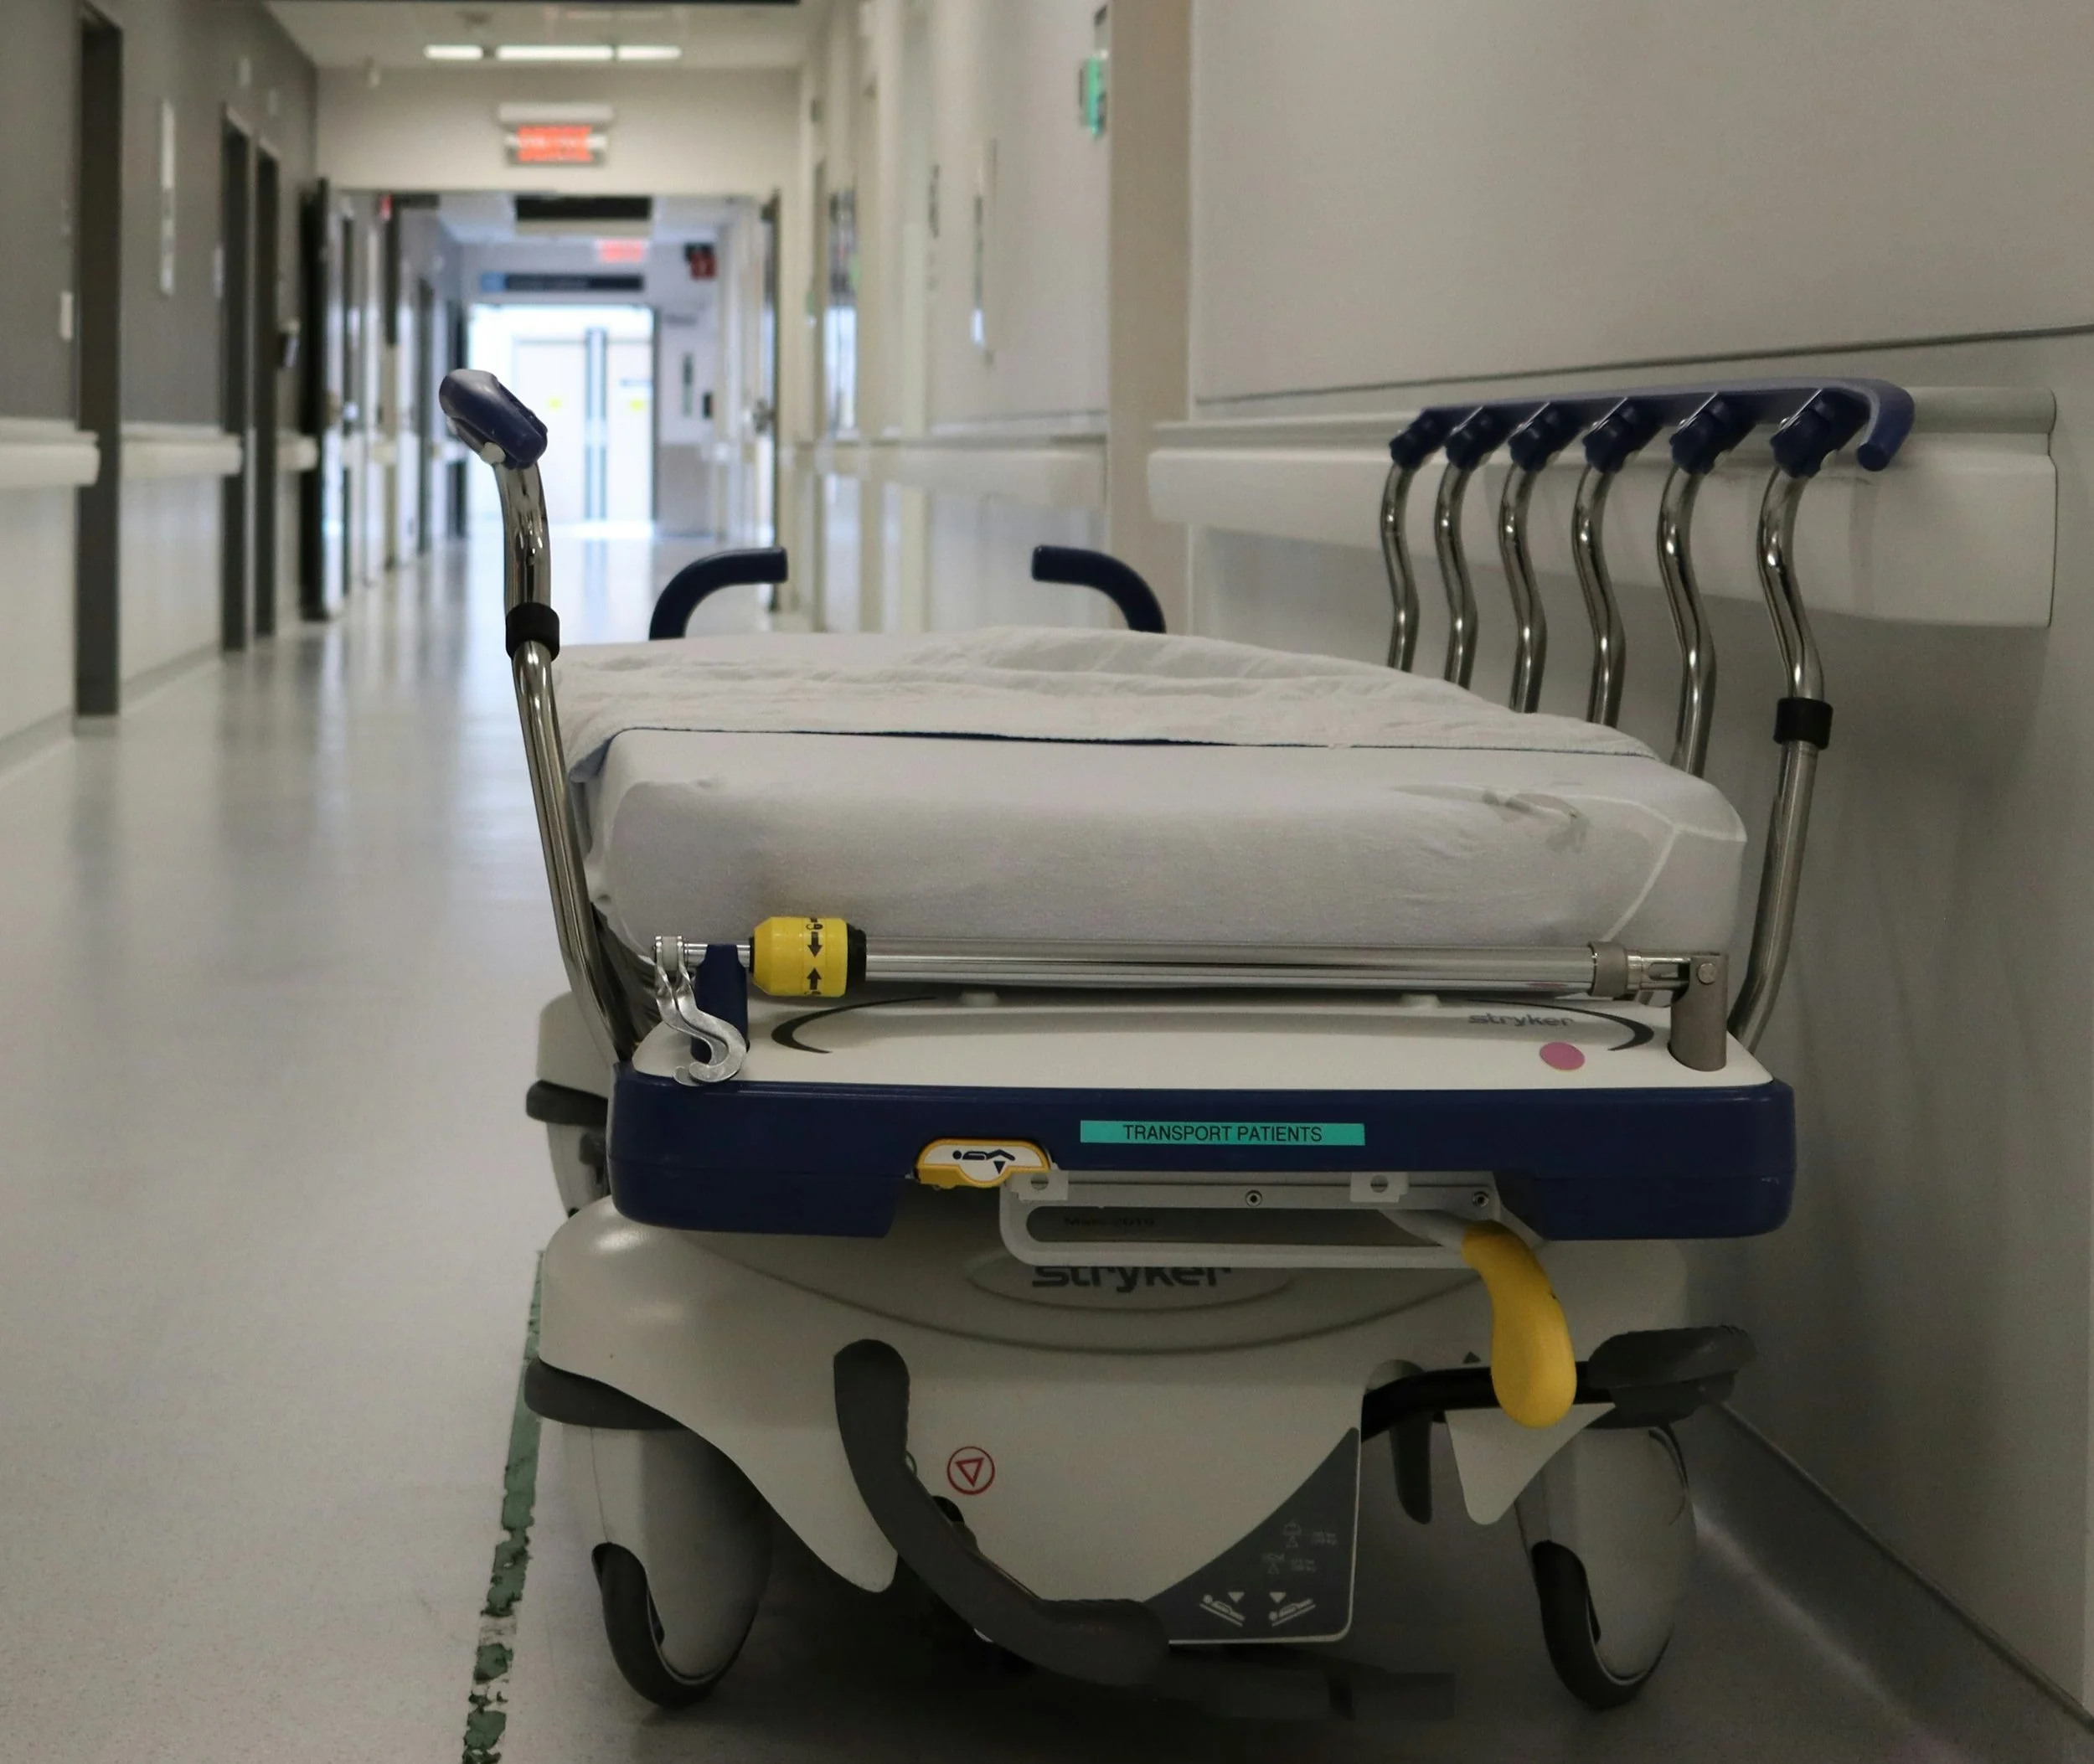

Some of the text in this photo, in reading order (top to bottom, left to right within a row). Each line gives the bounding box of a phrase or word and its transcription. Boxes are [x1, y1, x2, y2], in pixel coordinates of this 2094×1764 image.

[1468, 1014, 1575, 1027] stryker
[1123, 1124, 1323, 1143] TRANSPORT PATIENTS
